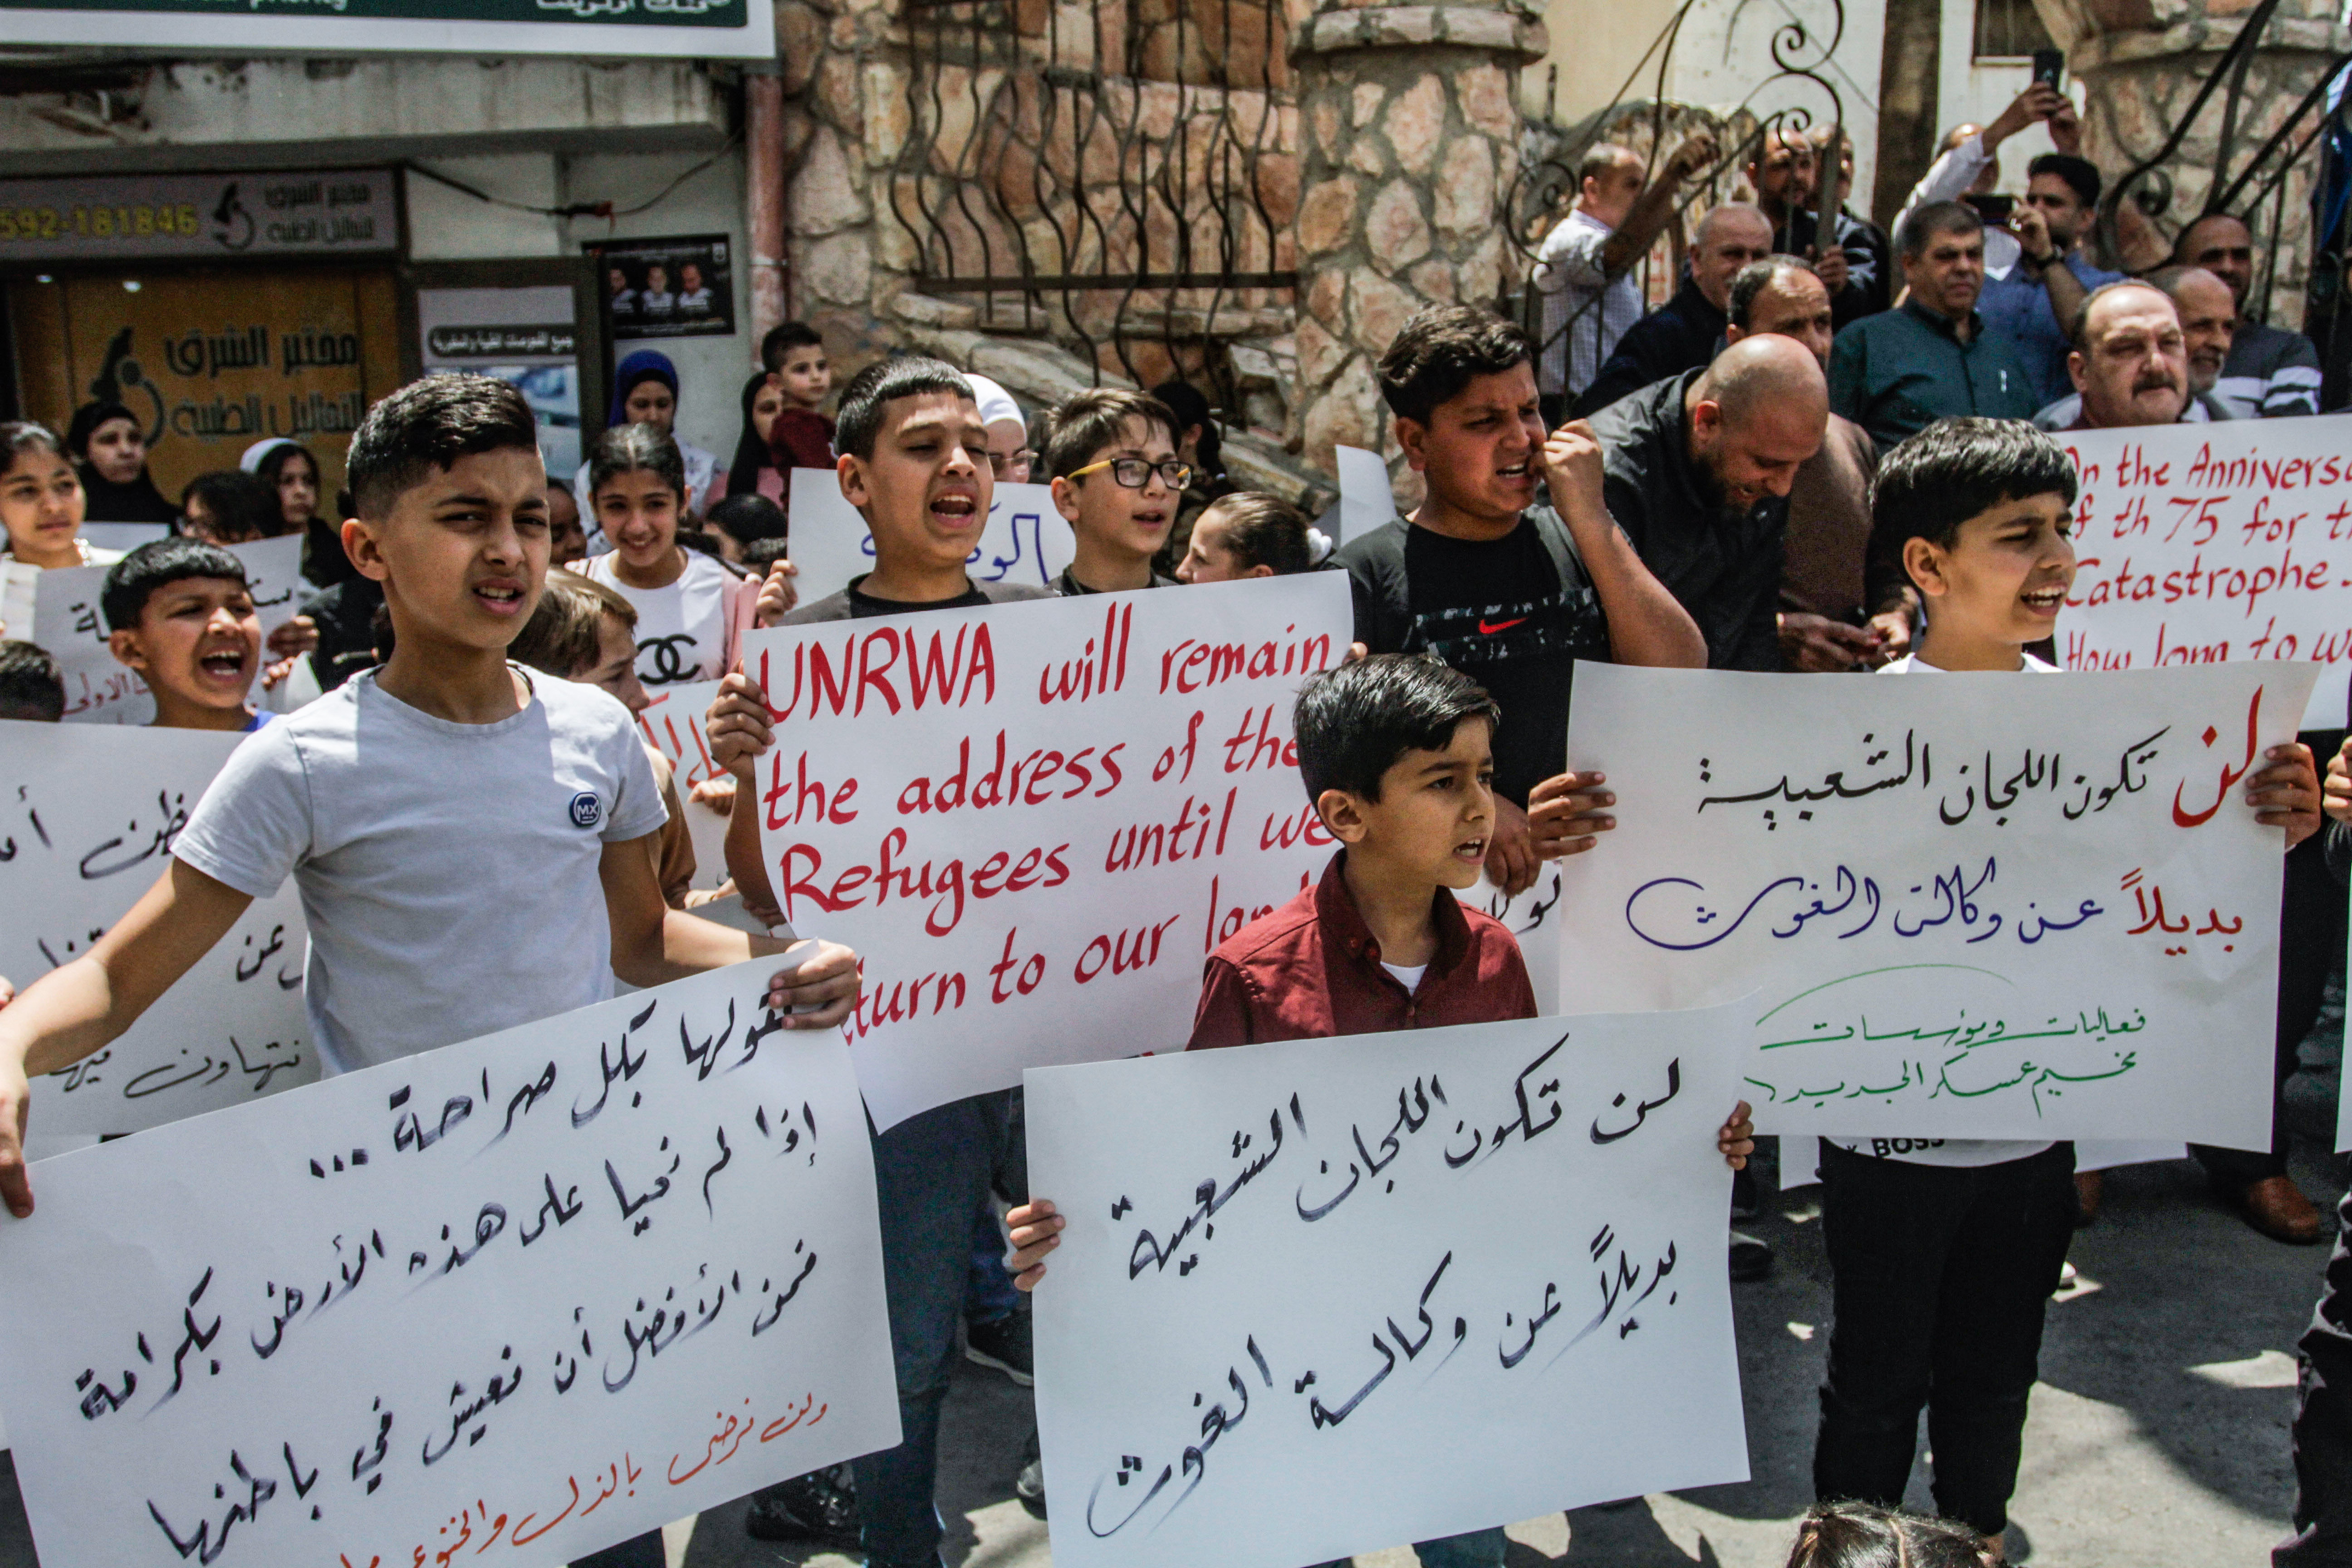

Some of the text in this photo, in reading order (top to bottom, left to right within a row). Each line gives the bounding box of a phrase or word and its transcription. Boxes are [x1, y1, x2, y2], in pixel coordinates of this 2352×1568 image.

[163, 323, 269, 379] الشرق
[2117, 442, 2170, 487] the
[2074, 493, 2352, 546] f th 75 for t
[759, 601, 1330, 723] UNRWA will remain
[2068, 630, 2131, 671] How
[2249, 616, 2297, 660] to
[2311, 628, 2352, 663] w
[763, 704, 1298, 831] the address of the
[1697, 684, 2264, 831] لن تكون اللجان الشعبية
[779, 786, 1336, 938] Refugees until we
[1626, 864, 1881, 951] الغوث
[2018, 899, 2104, 944] عن
[843, 962, 966, 1046] turn
[990, 927, 1045, 1004] to
[1075, 914, 1180, 985] our
[1967, 1006, 2146, 1049] فعاليات
[389, 1059, 557, 1162] صراحة
[571, 998, 657, 1128] بكل
[1928, 1051, 2038, 1099] عسكر
[702, 1125, 732, 1222] لم
[755, 1100, 817, 1168] إذا
[1111, 1032, 1681, 1281] لن تكون اللجان الشعبية
[520, 1172, 584, 1248] على
[605, 1135, 680, 1238] نحيا
[405, 1202, 508, 1299] هذه
[752, 1238, 817, 1337] فمن
[75, 1266, 222, 1420] بكرامة
[554, 1306, 592, 1395] أن
[1294, 1250, 1467, 1431] وكالة
[1499, 1282, 1562, 1369] عن
[352, 1395, 393, 1496] في
[423, 1344, 523, 1467] نعيش
[1086, 1333, 1274, 1538] الغوث
